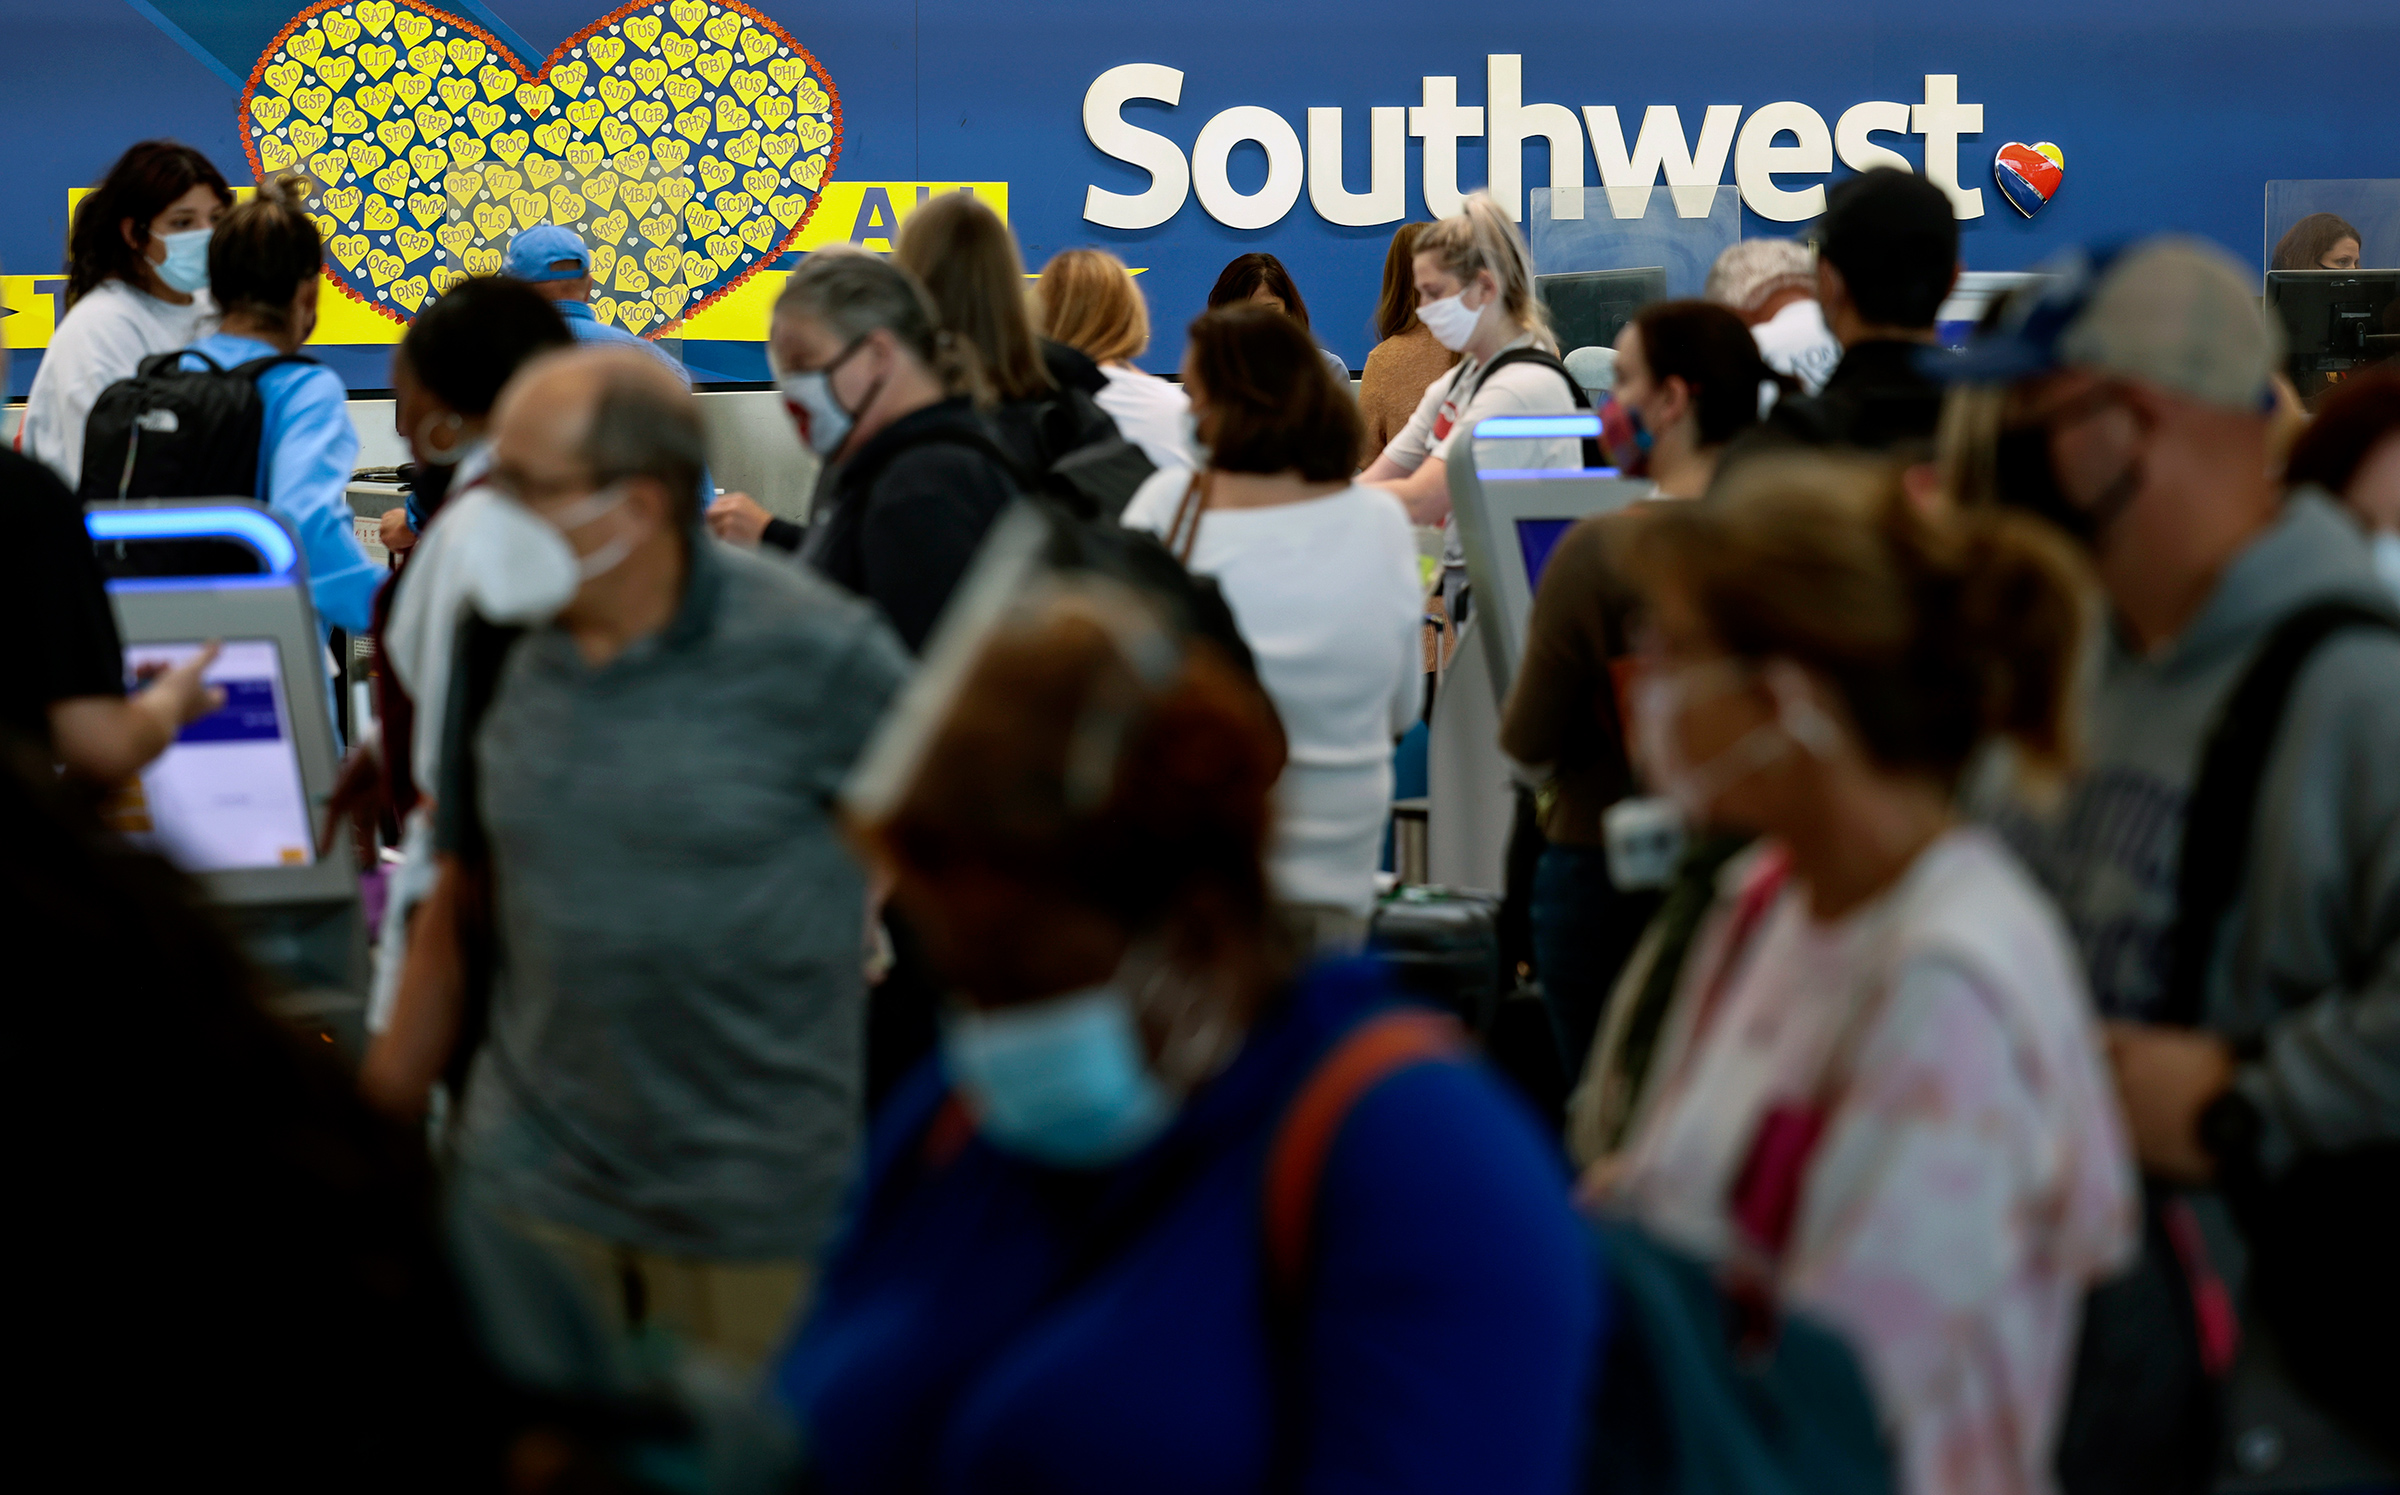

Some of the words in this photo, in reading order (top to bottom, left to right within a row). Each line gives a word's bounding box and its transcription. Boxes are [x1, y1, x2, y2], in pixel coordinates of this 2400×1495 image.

[361, 5, 392, 23] SAT
[674, 6, 704, 22] HOU
[326, 17, 357, 41] DEN
[397, 18, 427, 37] BUF
[626, 21, 656, 39] TUS
[709, 18, 737, 41] CHS
[291, 36, 321, 58] HRL
[451, 44, 483, 62] SMF
[587, 42, 620, 59] MAF
[664, 37, 694, 59] BUR
[743, 33, 773, 56] KOA
[364, 49, 391, 67] LIT
[414, 47, 444, 69] SEA
[700, 57, 726, 76] PBI
[271, 67, 299, 87] SJU
[319, 61, 350, 79] CLT
[478, 68, 509, 91] MCI
[554, 66, 587, 89] PDX
[634, 66, 661, 82] BOI
[773, 65, 800, 81] PHL
[401, 79, 426, 95] ISP
[440, 83, 472, 100] CVG
[604, 81, 631, 102] SJD
[666, 80, 697, 99] GEG
[733, 75, 762, 93] AUS
[297, 93, 326, 110] GSP
[362, 86, 394, 108] JAX
[518, 90, 548, 105] BWI
[794, 81, 829, 113] MDW
[252, 102, 289, 119] AMA
[335, 101, 362, 130] ECP
[470, 107, 500, 126] PUJ
[570, 103, 599, 123] CLE
[634, 107, 665, 123] LGB
[718, 100, 746, 129] OAK
[763, 101, 790, 117] IAD
[416, 111, 447, 132] GRR
[678, 112, 710, 135] PHX
[293, 127, 326, 149] RSW
[384, 125, 412, 143] SFO
[541, 125, 568, 148] ITO
[604, 122, 632, 145] SJC
[800, 121, 827, 143] SJO
[1082, 54, 1985, 229] Southwest
[261, 139, 292, 166] OMA
[453, 138, 482, 159] SDF
[495, 136, 527, 155] ROC
[656, 142, 685, 161] SNA
[728, 135, 759, 160] BZE
[765, 138, 798, 155] DSM
[314, 156, 347, 177] PVR
[351, 146, 379, 168] BNA
[414, 153, 443, 170] STL
[569, 148, 599, 165] BDL
[616, 150, 646, 173] MSP
[378, 165, 409, 191] OKC
[528, 159, 555, 179] LIR
[700, 160, 729, 183] BOS
[793, 159, 822, 182] HAV
[448, 176, 477, 193] ORF
[487, 172, 516, 190] ATL
[585, 174, 618, 199] CZM
[661, 183, 693, 199] LGA
[747, 173, 777, 191] RNO
[324, 189, 363, 211] MEM
[551, 189, 580, 220] LBB
[620, 186, 654, 203] MBJ
[716, 196, 751, 213] GCM
[365, 199, 393, 225] ELP
[409, 198, 445, 217] PWM
[513, 196, 542, 219] TUL
[776, 199, 803, 217] ICT
[478, 211, 505, 229] PLS
[593, 213, 626, 240] MKE
[641, 218, 675, 237] BHM
[686, 208, 715, 232] HNL
[440, 228, 471, 246] RDU
[742, 219, 776, 243] CMH
[337, 240, 365, 257] RIC
[399, 232, 429, 251] CRP
[710, 240, 738, 257] NAS
[368, 254, 400, 280] OGG
[469, 255, 499, 273] SAN
[589, 252, 612, 272] AS
[647, 252, 677, 272] MSY
[683, 257, 715, 281] CUN
[620, 262, 645, 289] SLC
[395, 281, 424, 302] PNS
[656, 289, 690, 306] DTW
[595, 300, 611, 320] IT
[620, 306, 653, 321] MCO
